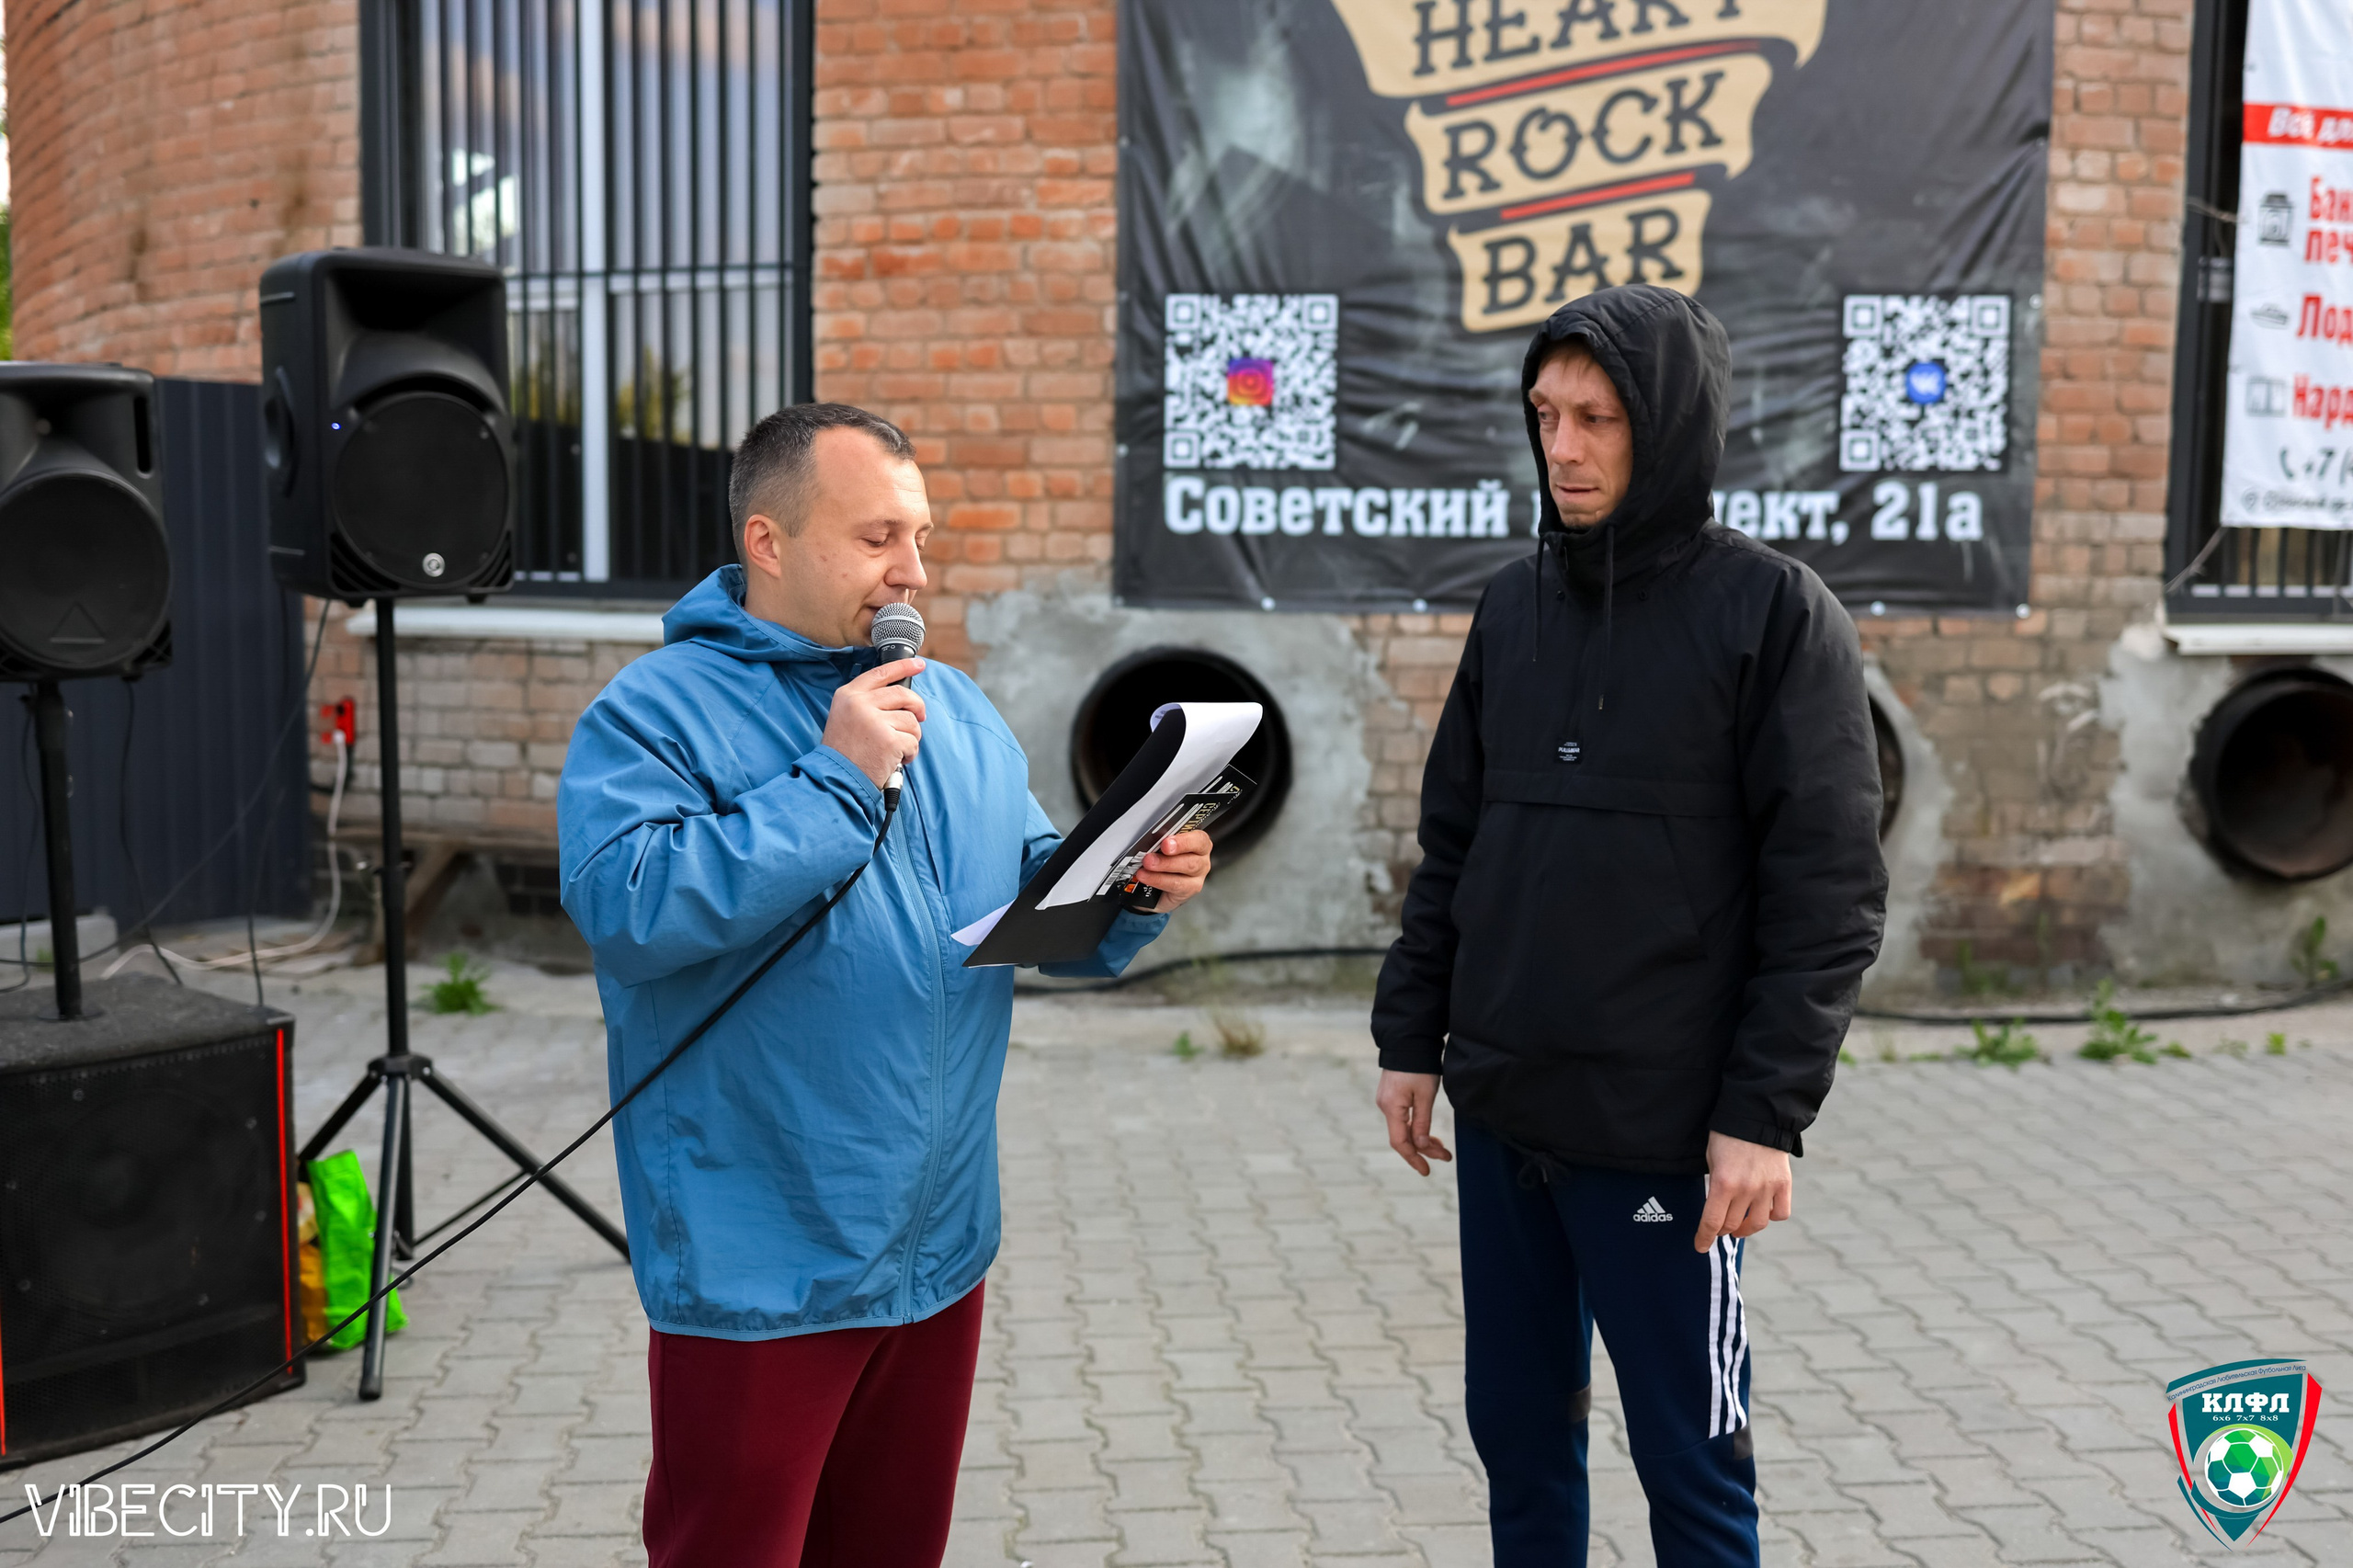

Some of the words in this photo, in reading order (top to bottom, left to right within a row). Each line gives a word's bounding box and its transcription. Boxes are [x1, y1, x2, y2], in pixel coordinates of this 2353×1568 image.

[1413, 0, 1741, 76] HEA
[1440, 71, 1725, 200] ROCK
[1482, 209, 1685, 315] BAR
[1164, 475, 1511, 539] Советский
[1870, 480, 1984, 541] 21а
[1178, 802, 1217, 834] СЕРТИ
[1632, 1213, 1673, 1222] adidas
